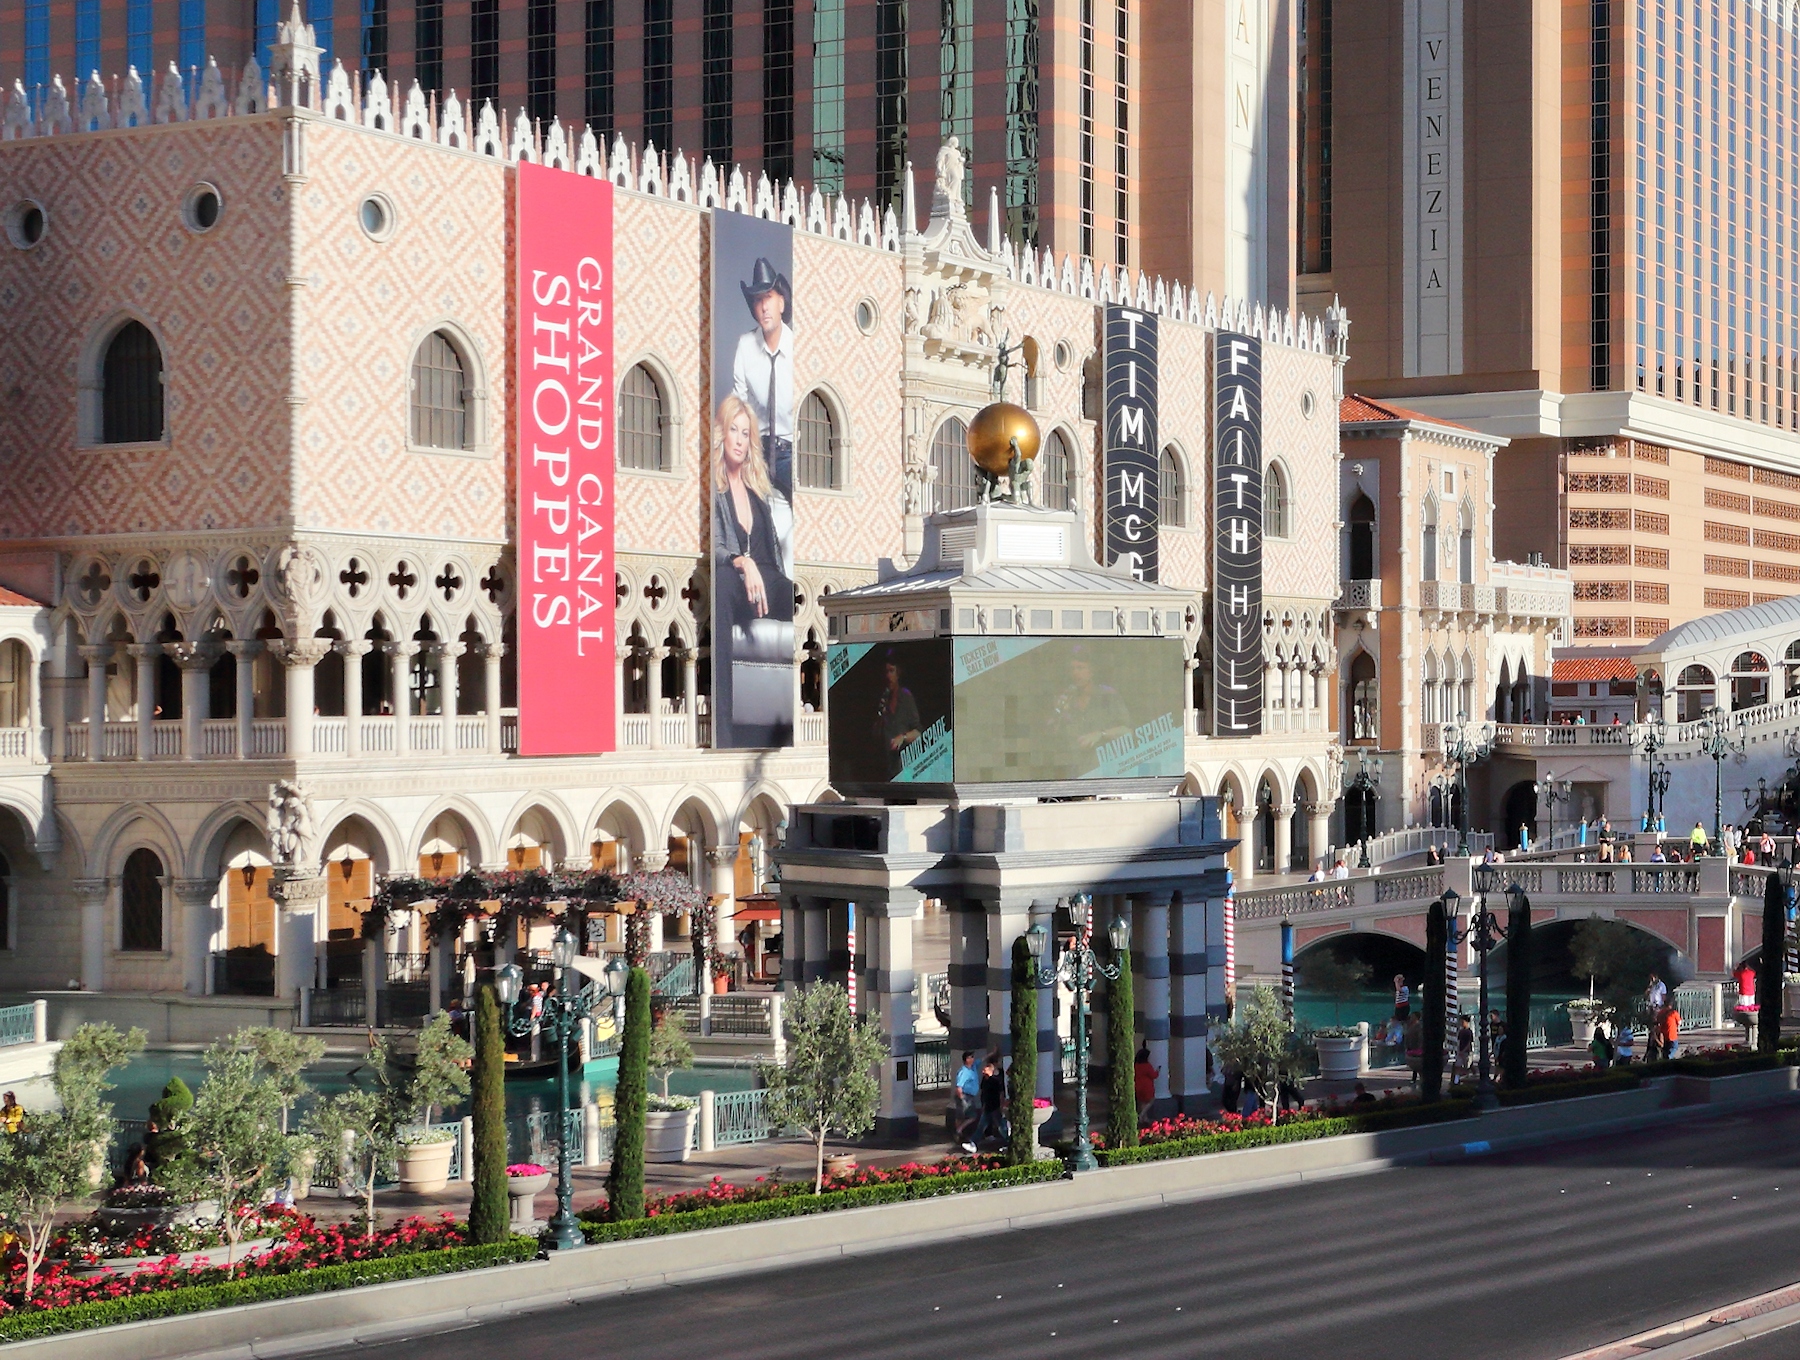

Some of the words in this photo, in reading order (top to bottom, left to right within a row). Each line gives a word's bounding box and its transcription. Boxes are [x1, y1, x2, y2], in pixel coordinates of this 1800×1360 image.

[1425, 39, 1443, 291] VENEZIA
[577, 256, 603, 451] GRAND
[1120, 310, 1145, 447] TIM
[532, 269, 571, 630] SHOPPES
[1230, 340, 1250, 556] FAITH
[577, 472, 603, 657] CANAL
[960, 645, 987, 666] TICKETS
[966, 659, 984, 676] SALE
[983, 651, 1000, 669] NOW
[1231, 585, 1250, 731] HILL
[900, 737, 923, 769] DAVID
[1095, 731, 1135, 763] DAVID
[1134, 712, 1174, 745] SPADE
